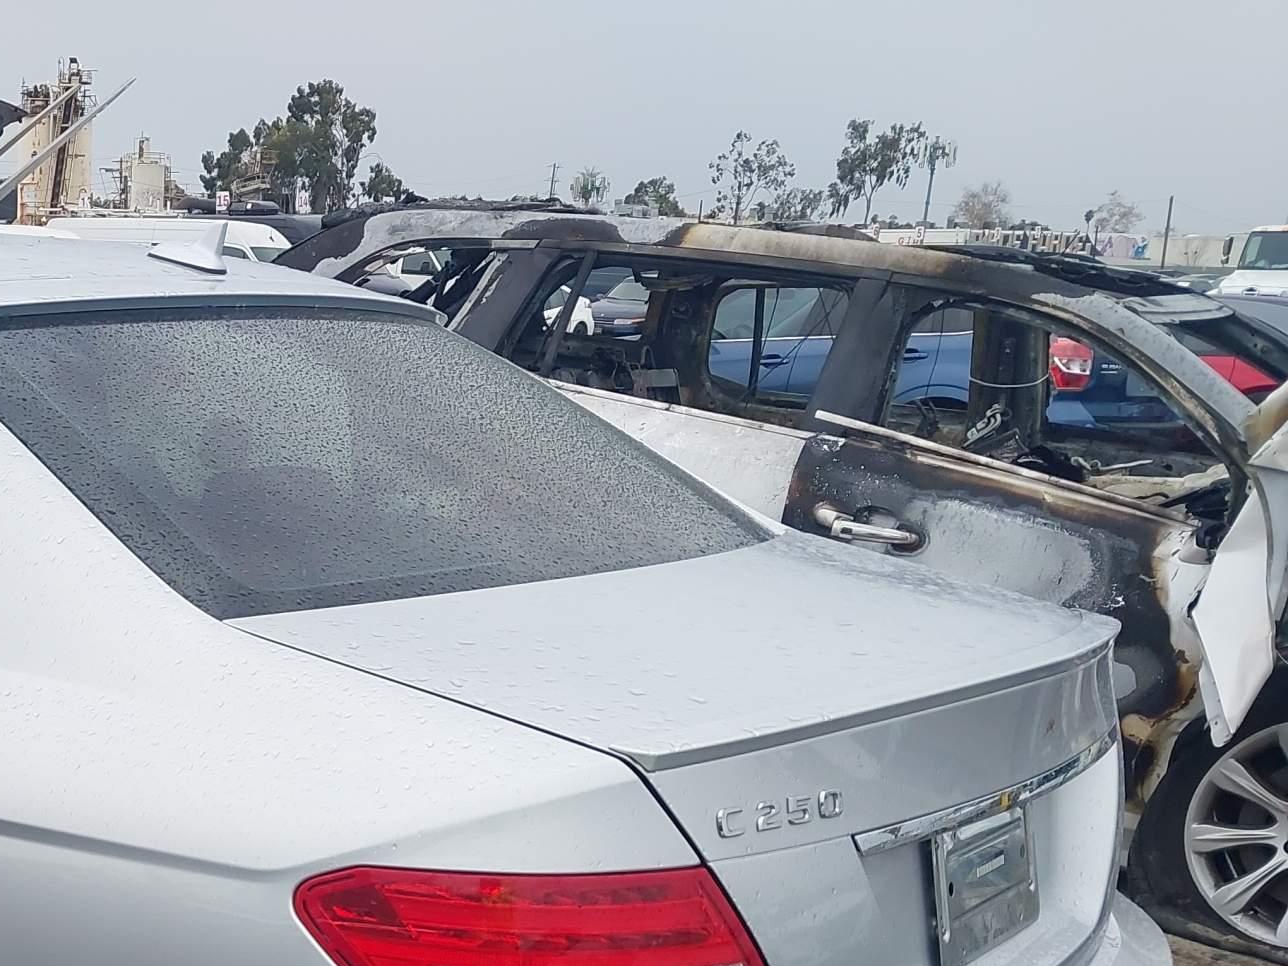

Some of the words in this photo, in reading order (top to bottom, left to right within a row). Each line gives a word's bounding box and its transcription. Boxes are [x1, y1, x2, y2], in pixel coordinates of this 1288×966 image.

[216, 194, 230, 207] 15
[916, 228, 923, 239] 5
[715, 806, 746, 839] C
[755, 789, 844, 833] 250
